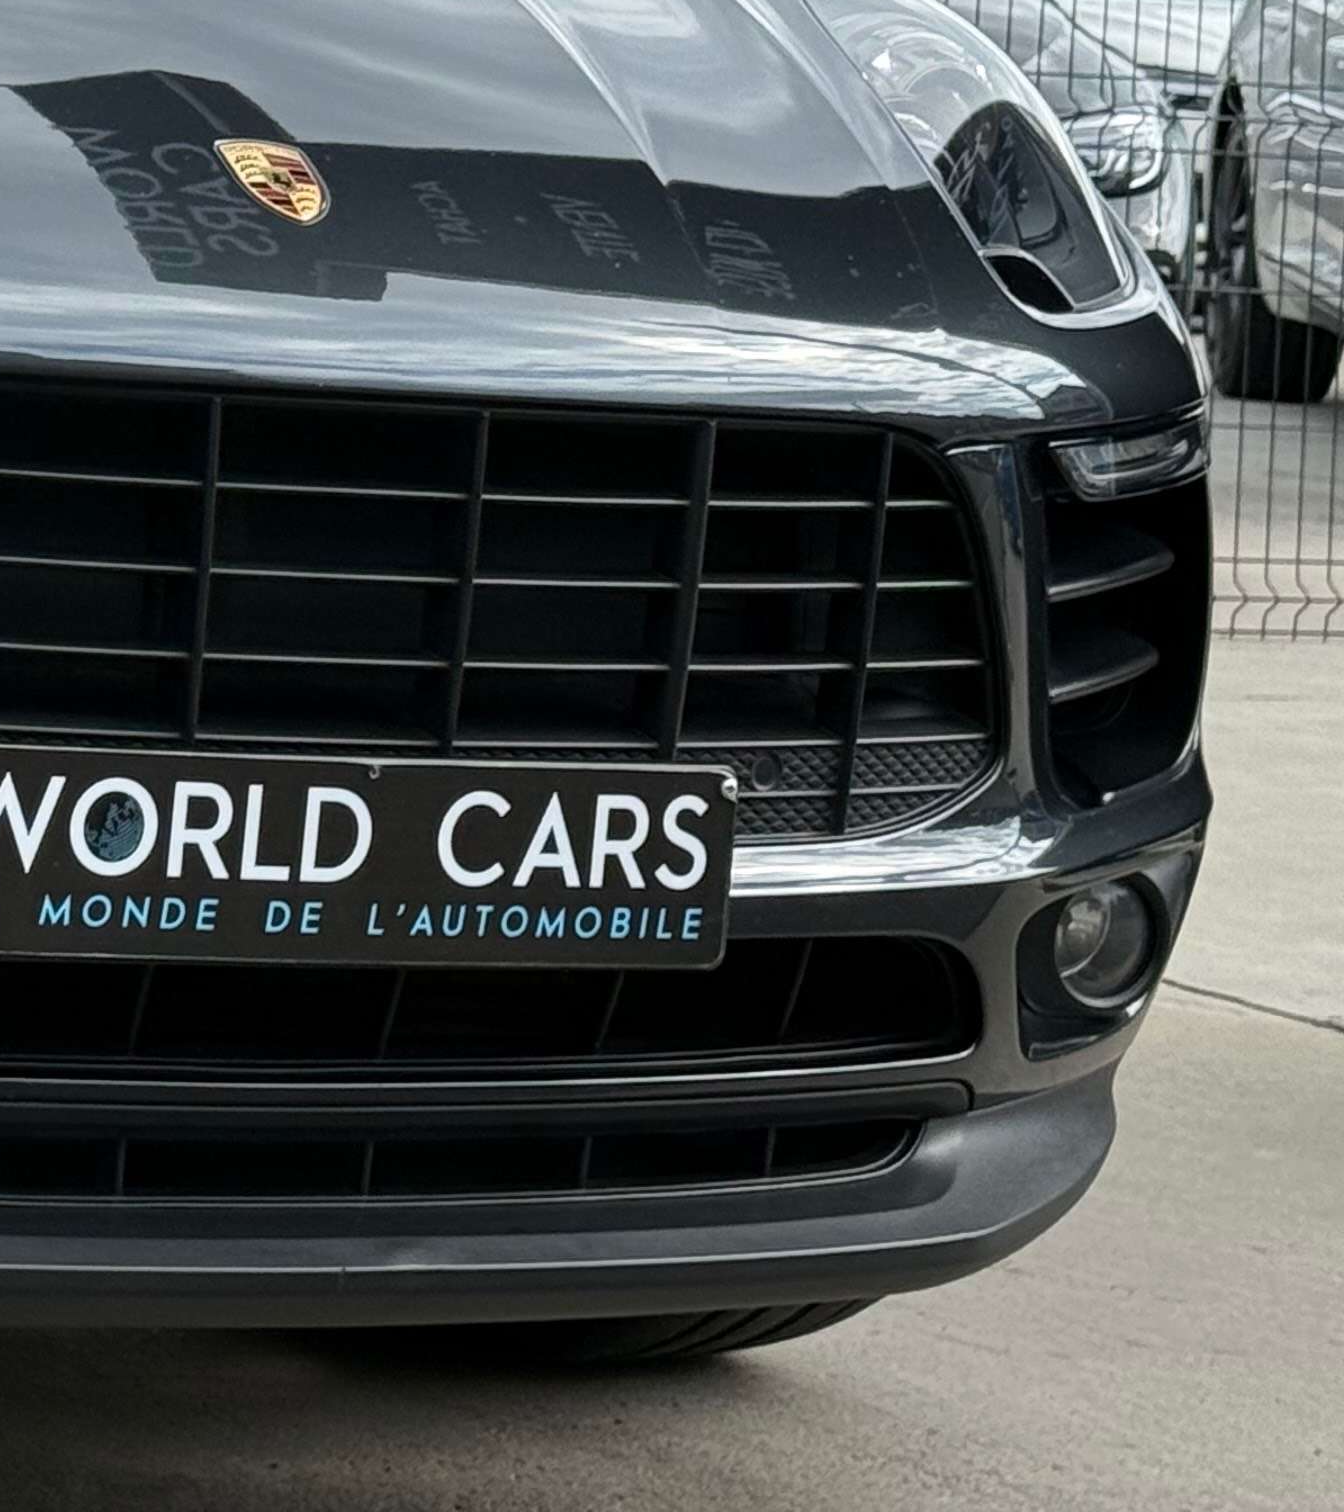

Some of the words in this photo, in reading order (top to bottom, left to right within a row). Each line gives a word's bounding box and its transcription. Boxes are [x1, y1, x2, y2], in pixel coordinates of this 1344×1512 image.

[436, 790, 710, 891] CARS
[37, 893, 219, 932] MONDE
[264, 900, 324, 935] DE
[366, 903, 704, 941] L'AUTOMOBILE
